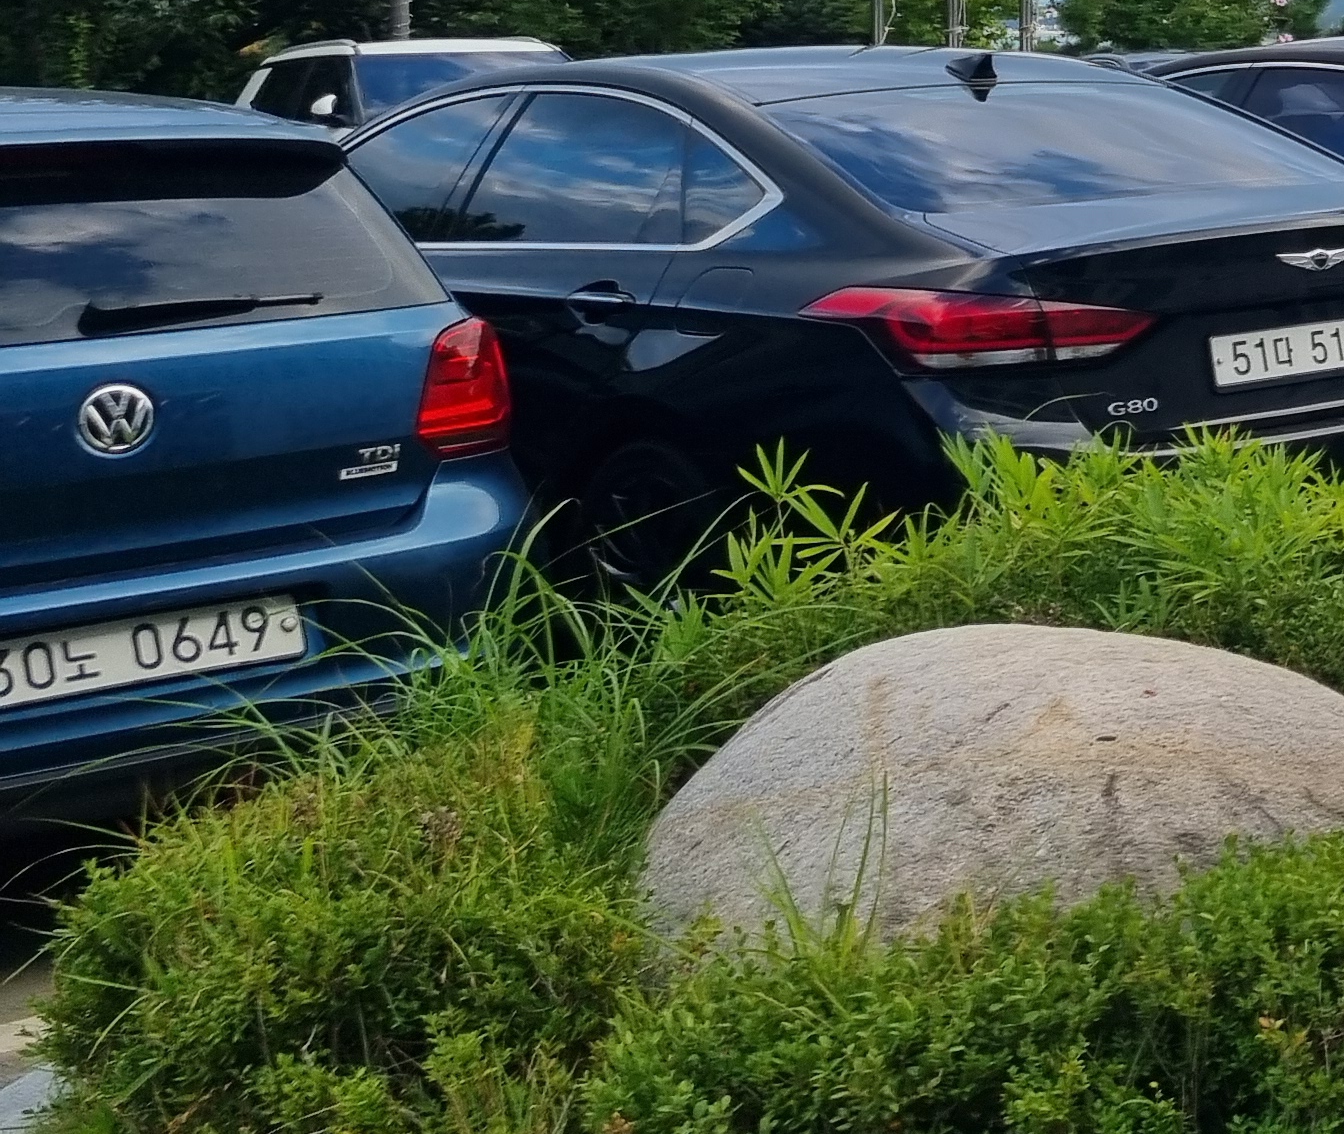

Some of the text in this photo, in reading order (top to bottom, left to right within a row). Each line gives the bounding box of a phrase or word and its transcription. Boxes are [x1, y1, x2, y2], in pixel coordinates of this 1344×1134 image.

[1231, 336, 1294, 376] 51다
[1107, 397, 1159, 416] G80
[358, 443, 402, 464] TDI
[131, 605, 271, 670] 0649
